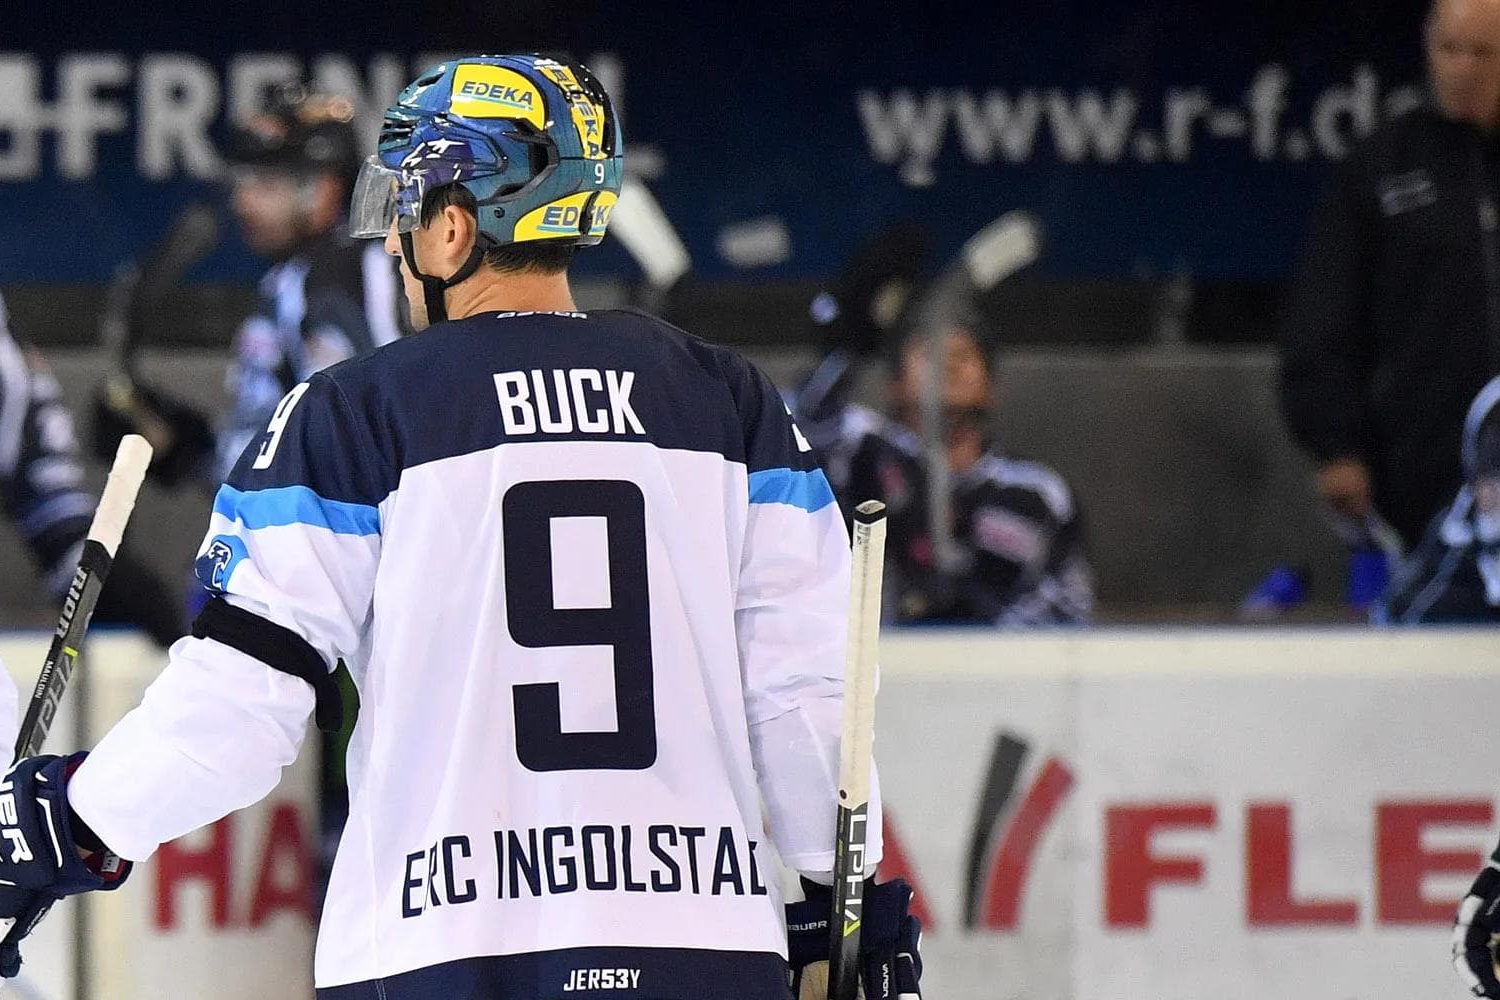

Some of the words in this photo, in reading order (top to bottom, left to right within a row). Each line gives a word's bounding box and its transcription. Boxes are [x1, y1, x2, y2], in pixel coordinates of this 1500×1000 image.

[462, 81, 534, 106] EDEKA
[594, 163, 605, 185] 9
[251, 382, 310, 470] 9
[492, 368, 647, 436] BUCK
[502, 479, 656, 772] 9
[402, 834, 478, 919] ERC
[563, 968, 641, 992] JER53Y
